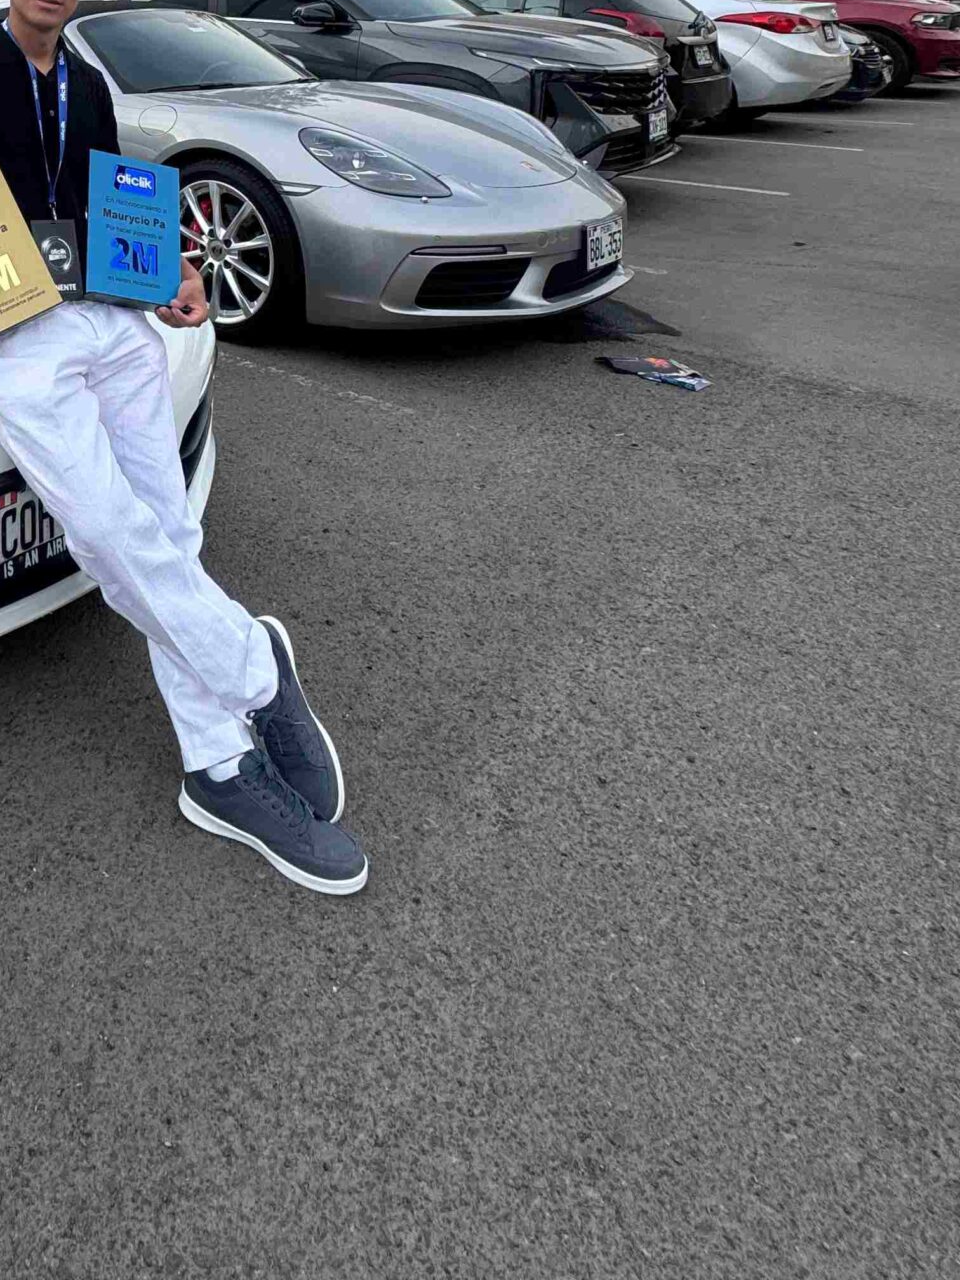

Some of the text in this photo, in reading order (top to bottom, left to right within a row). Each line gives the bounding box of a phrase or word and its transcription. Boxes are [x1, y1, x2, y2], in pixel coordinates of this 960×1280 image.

[117, 173, 153, 190] aliclik
[102, 207, 166, 229] Maurycio Pa
[110, 237, 159, 276] 2M
[4, 560, 14, 579] IS
[25, 548, 39, 568] AN
